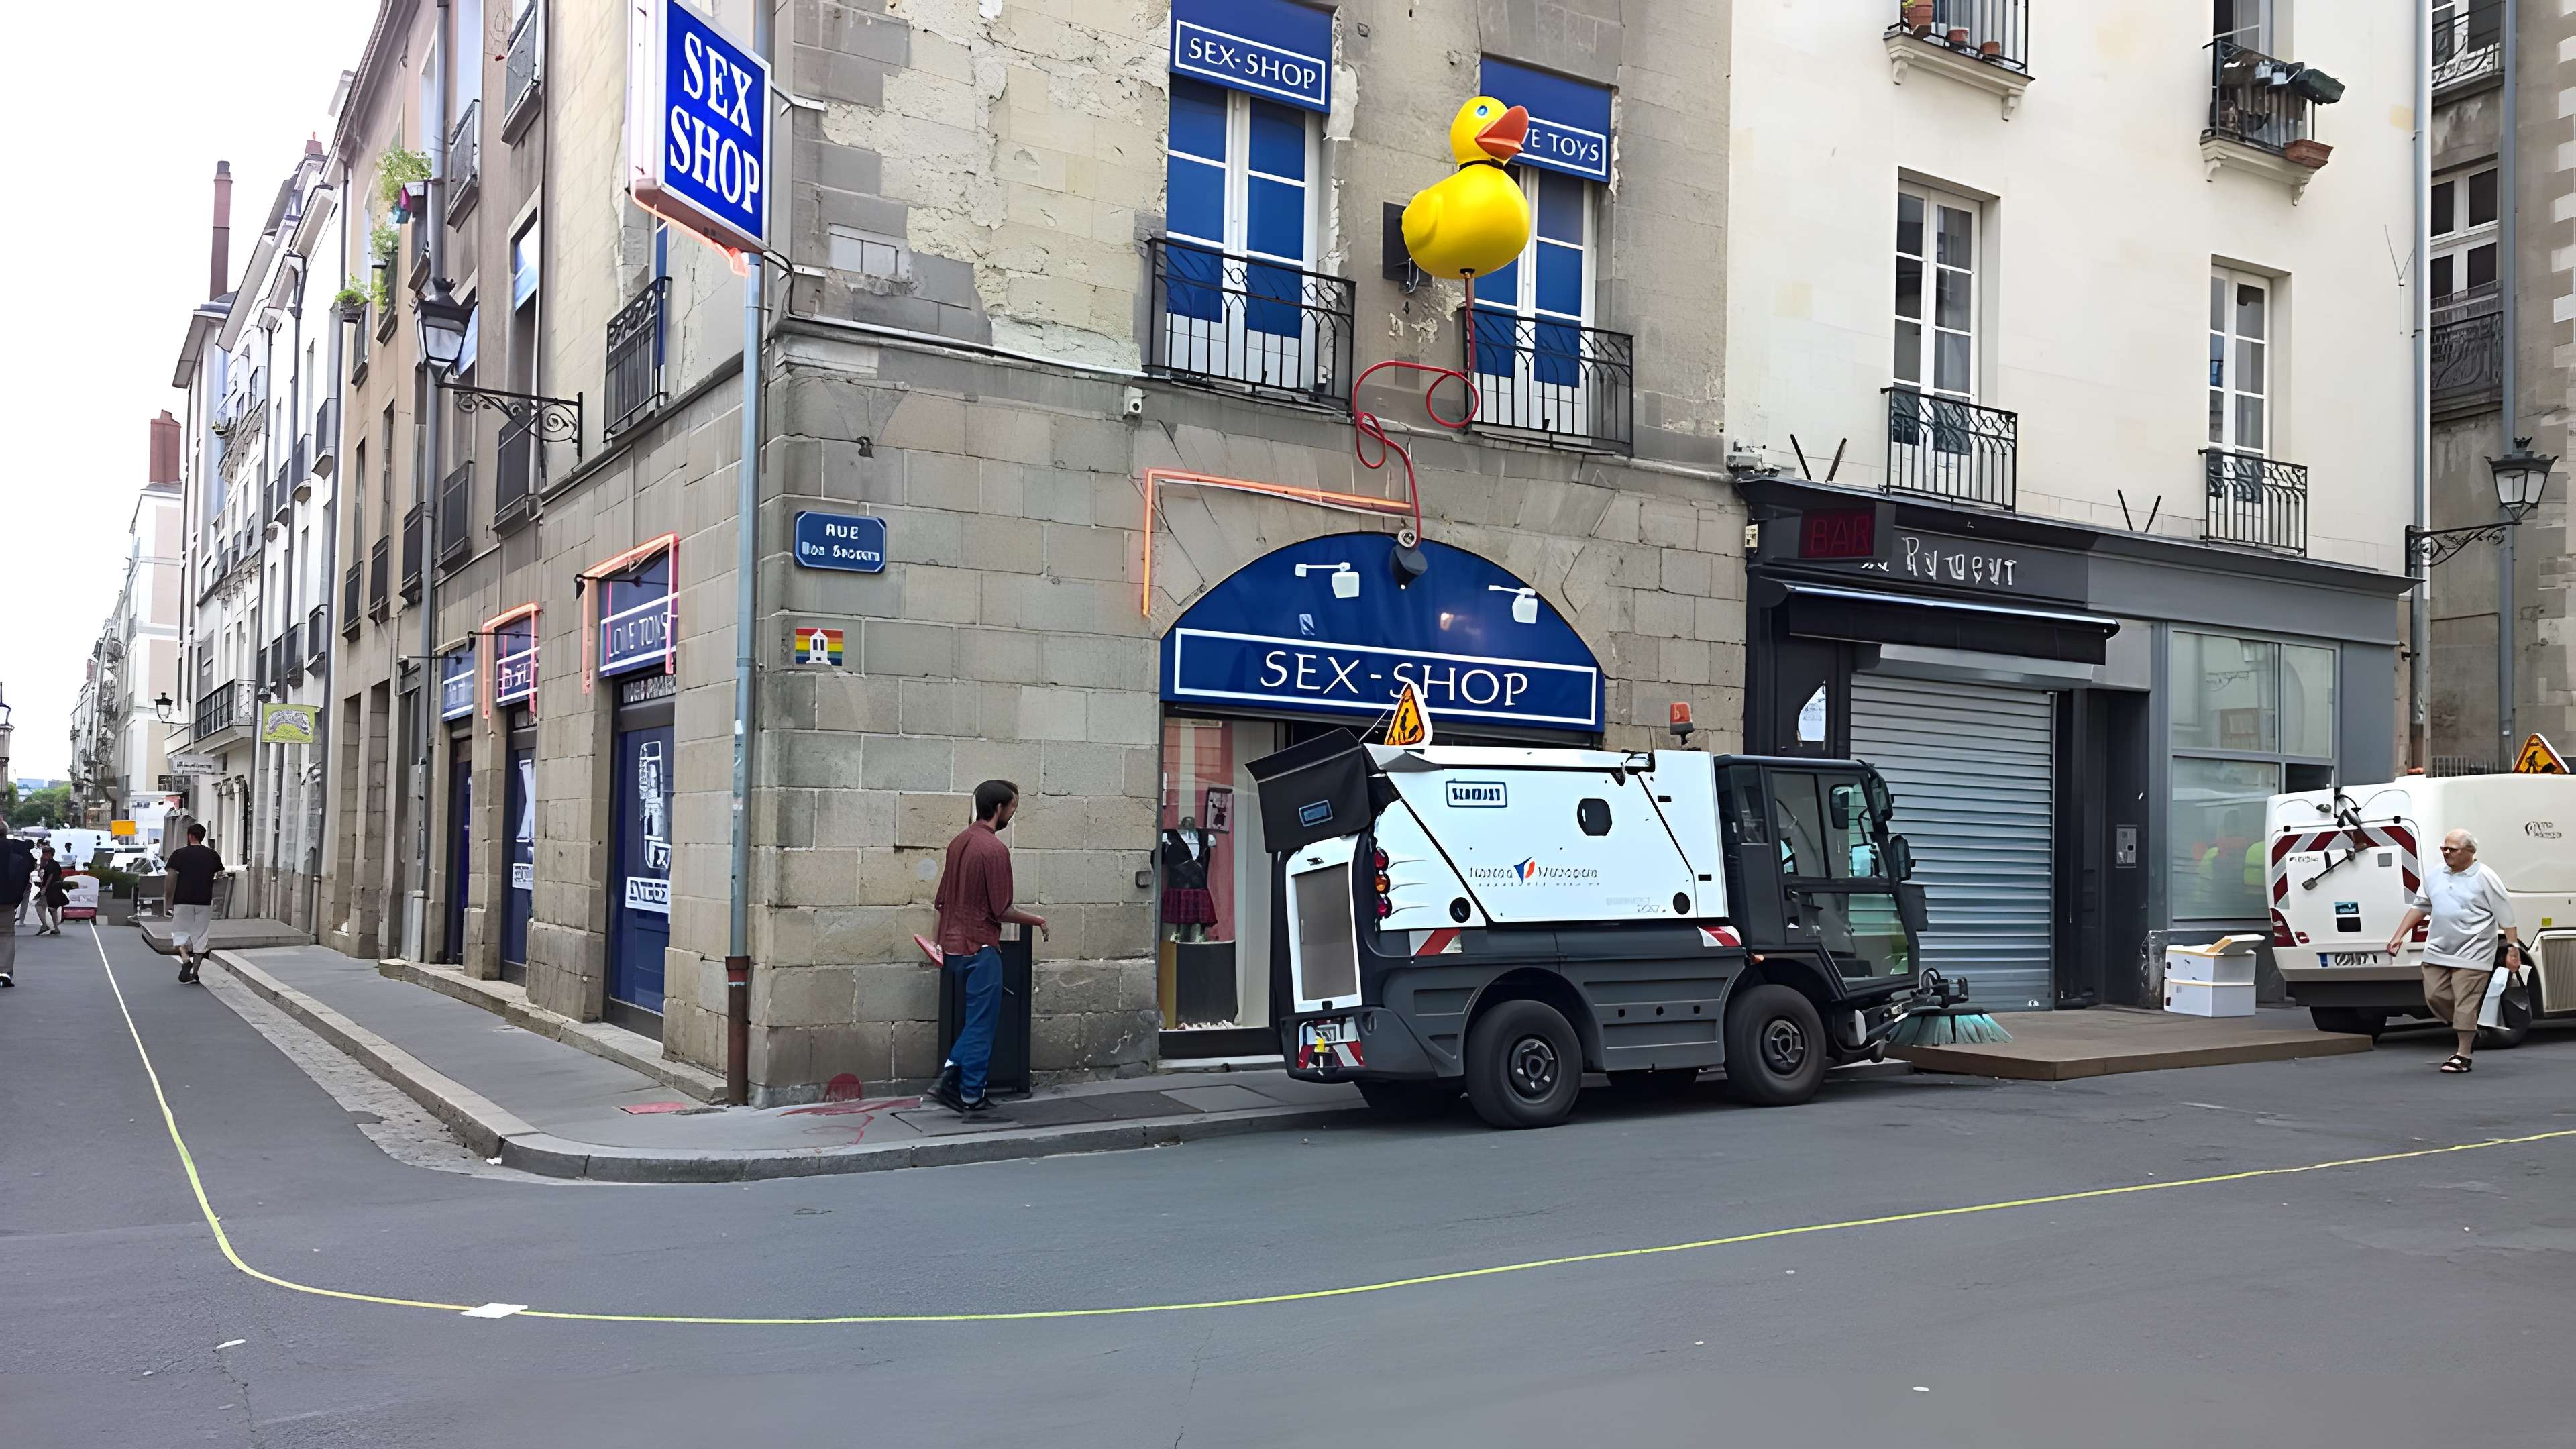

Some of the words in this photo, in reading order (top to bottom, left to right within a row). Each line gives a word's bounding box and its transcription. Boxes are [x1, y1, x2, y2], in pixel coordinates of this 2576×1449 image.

[684, 32, 753, 138] SEX
[1188, 37, 1316, 89] SEX-SHOP
[670, 105, 760, 215] SHOP
[1547, 133, 1599, 162] TOYS
[826, 523, 859, 539] RUE
[1810, 515, 1872, 555] BAR
[1260, 650, 1529, 706] SEX-SHOP
